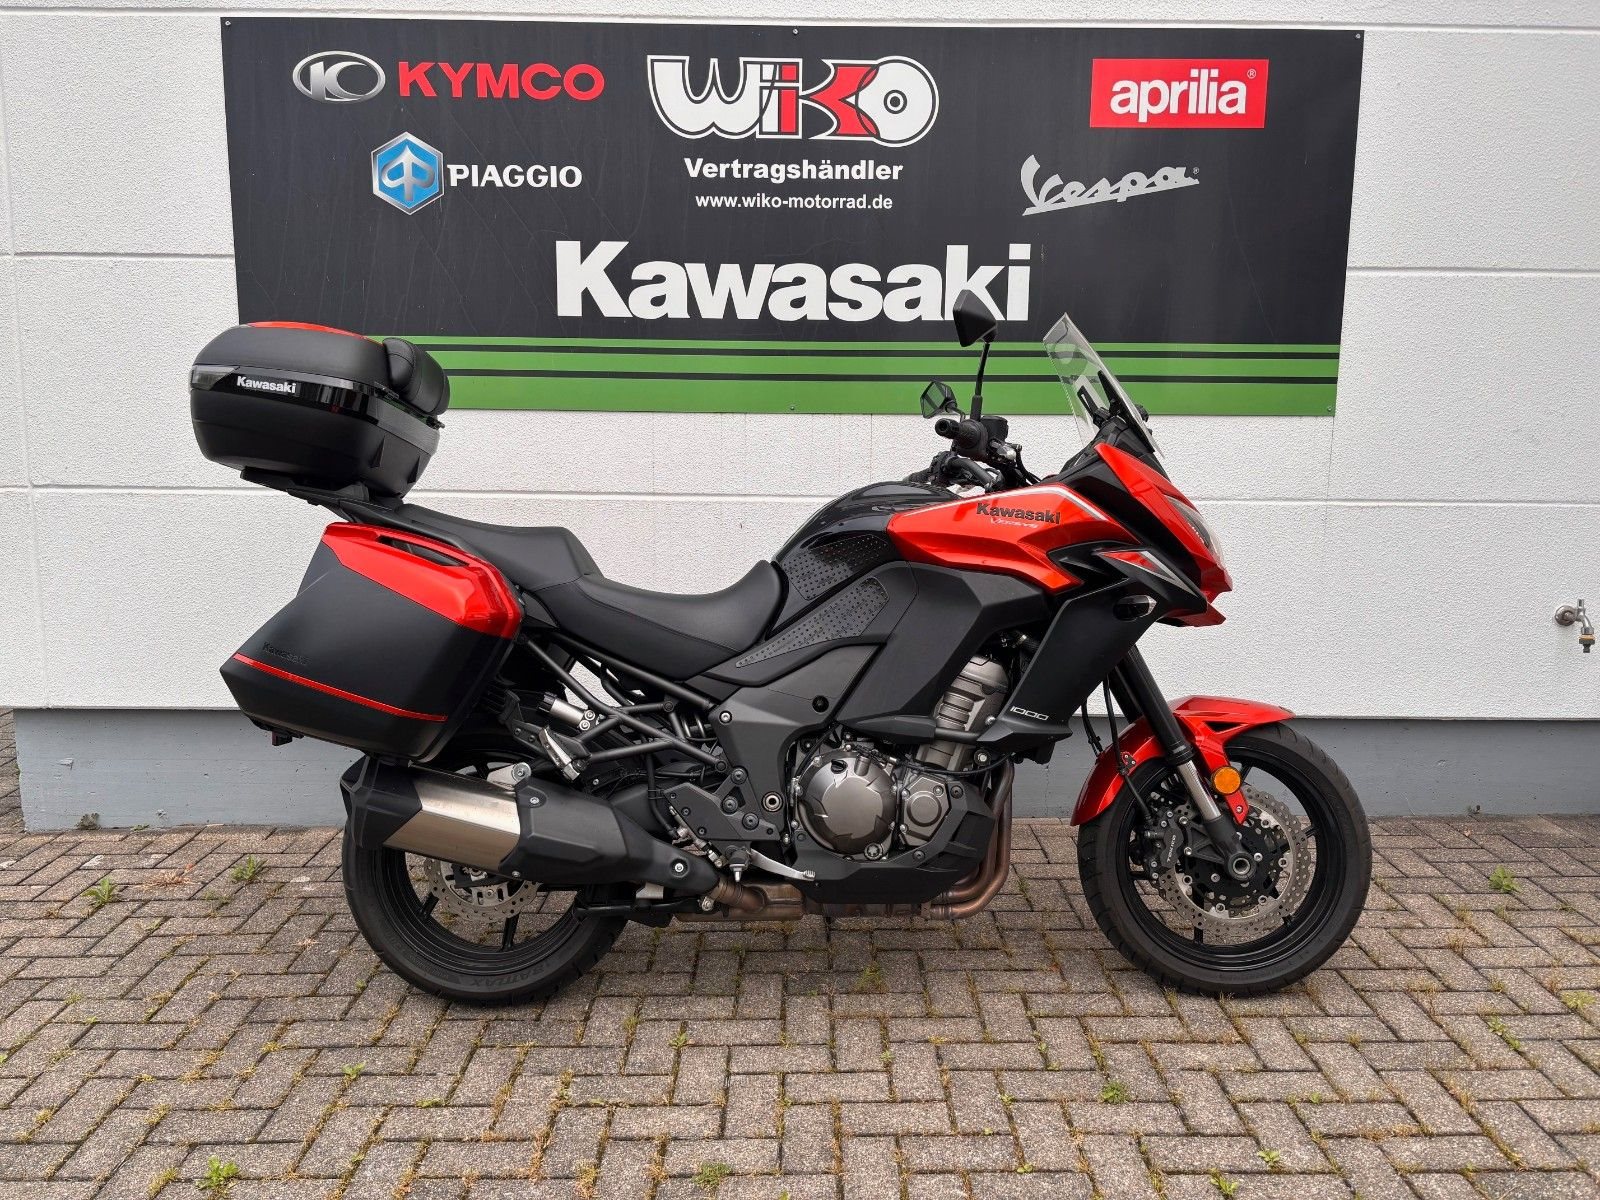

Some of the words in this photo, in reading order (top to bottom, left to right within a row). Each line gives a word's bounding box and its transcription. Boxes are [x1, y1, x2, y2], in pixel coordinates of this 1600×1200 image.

[398, 61, 605, 100] KYMCO
[447, 164, 583, 187] PIAGGIO
[684, 158, 903, 184] Vertragshändler
[1021, 154, 1200, 216] Vespa
[695, 192, 893, 210] www.wiko-motorrad.de
[555, 240, 1031, 322] Kawasaki
[236, 375, 297, 394] Kawasaki
[976, 502, 1061, 525] Kawasaki
[262, 641, 310, 665] Kawasak
[1010, 705, 1050, 721] 1000
